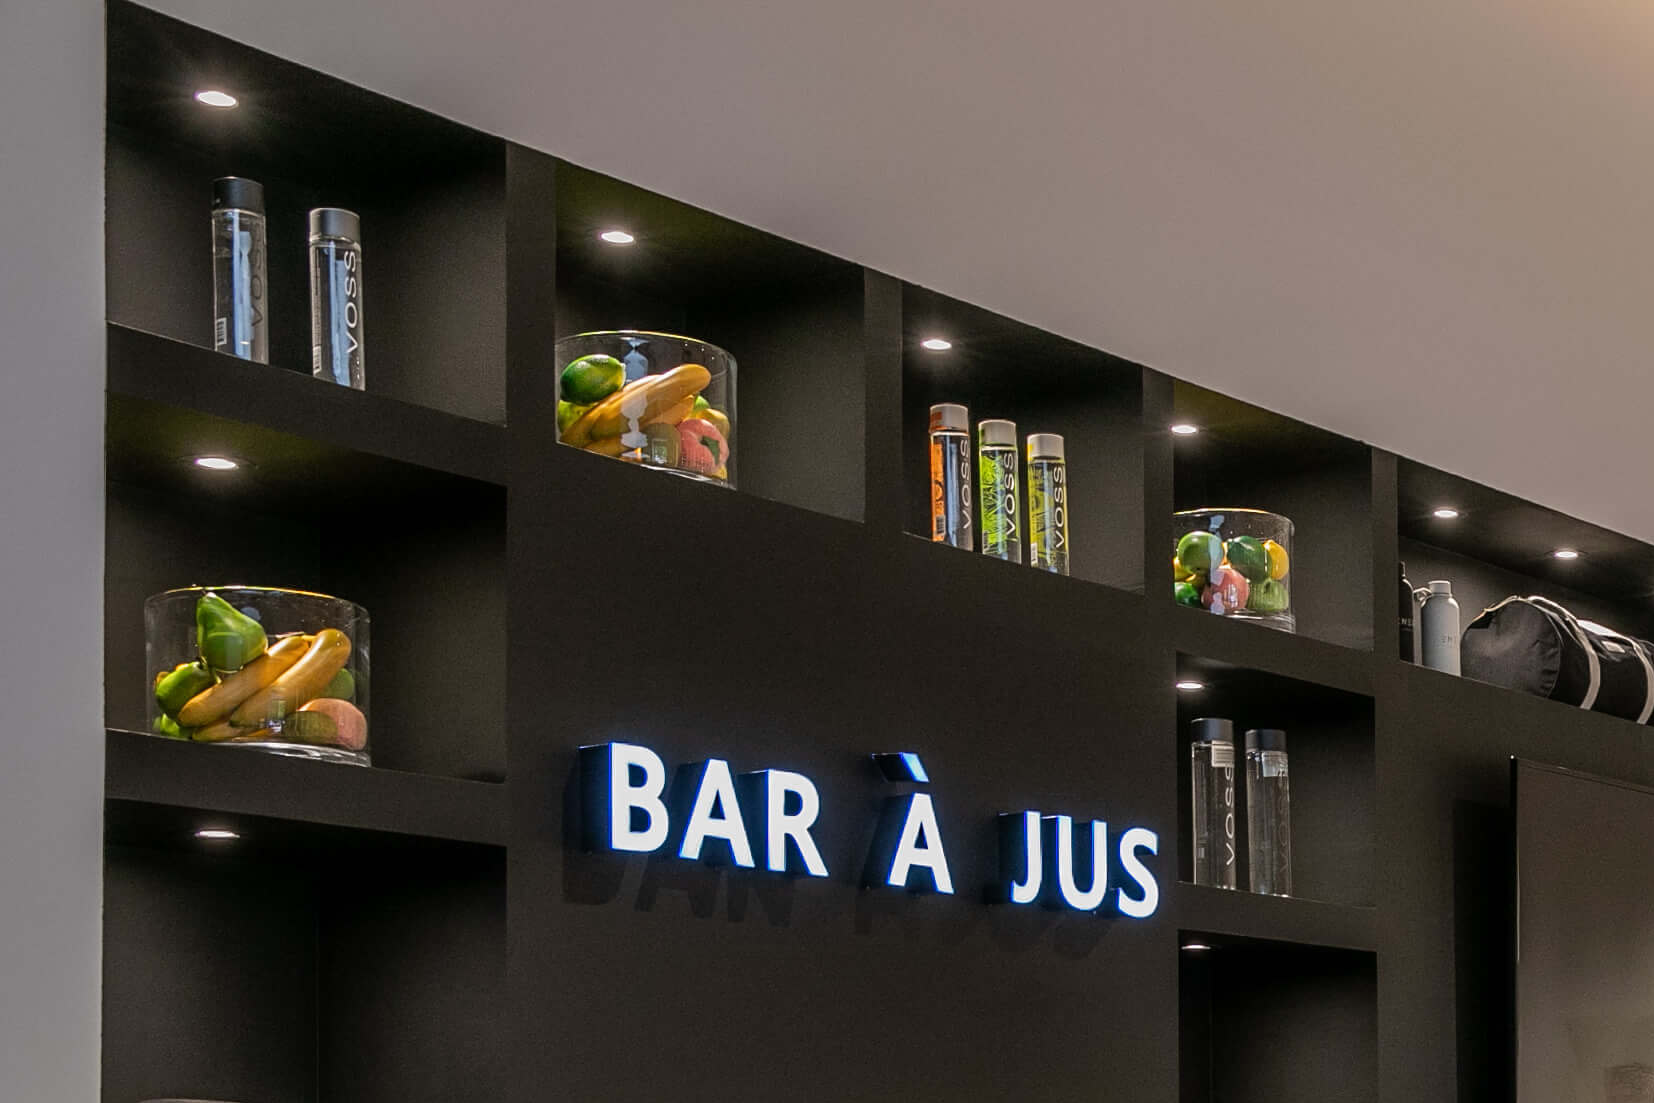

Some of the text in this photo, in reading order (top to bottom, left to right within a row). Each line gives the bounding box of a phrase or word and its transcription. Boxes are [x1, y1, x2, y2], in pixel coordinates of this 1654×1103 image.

[344, 250, 359, 353] VOSS
[960, 439, 972, 529] VOSS
[1003, 452, 1018, 535] VOSS
[1053, 464, 1065, 548] VOSS
[609, 741, 1160, 919] BAR À JUS
